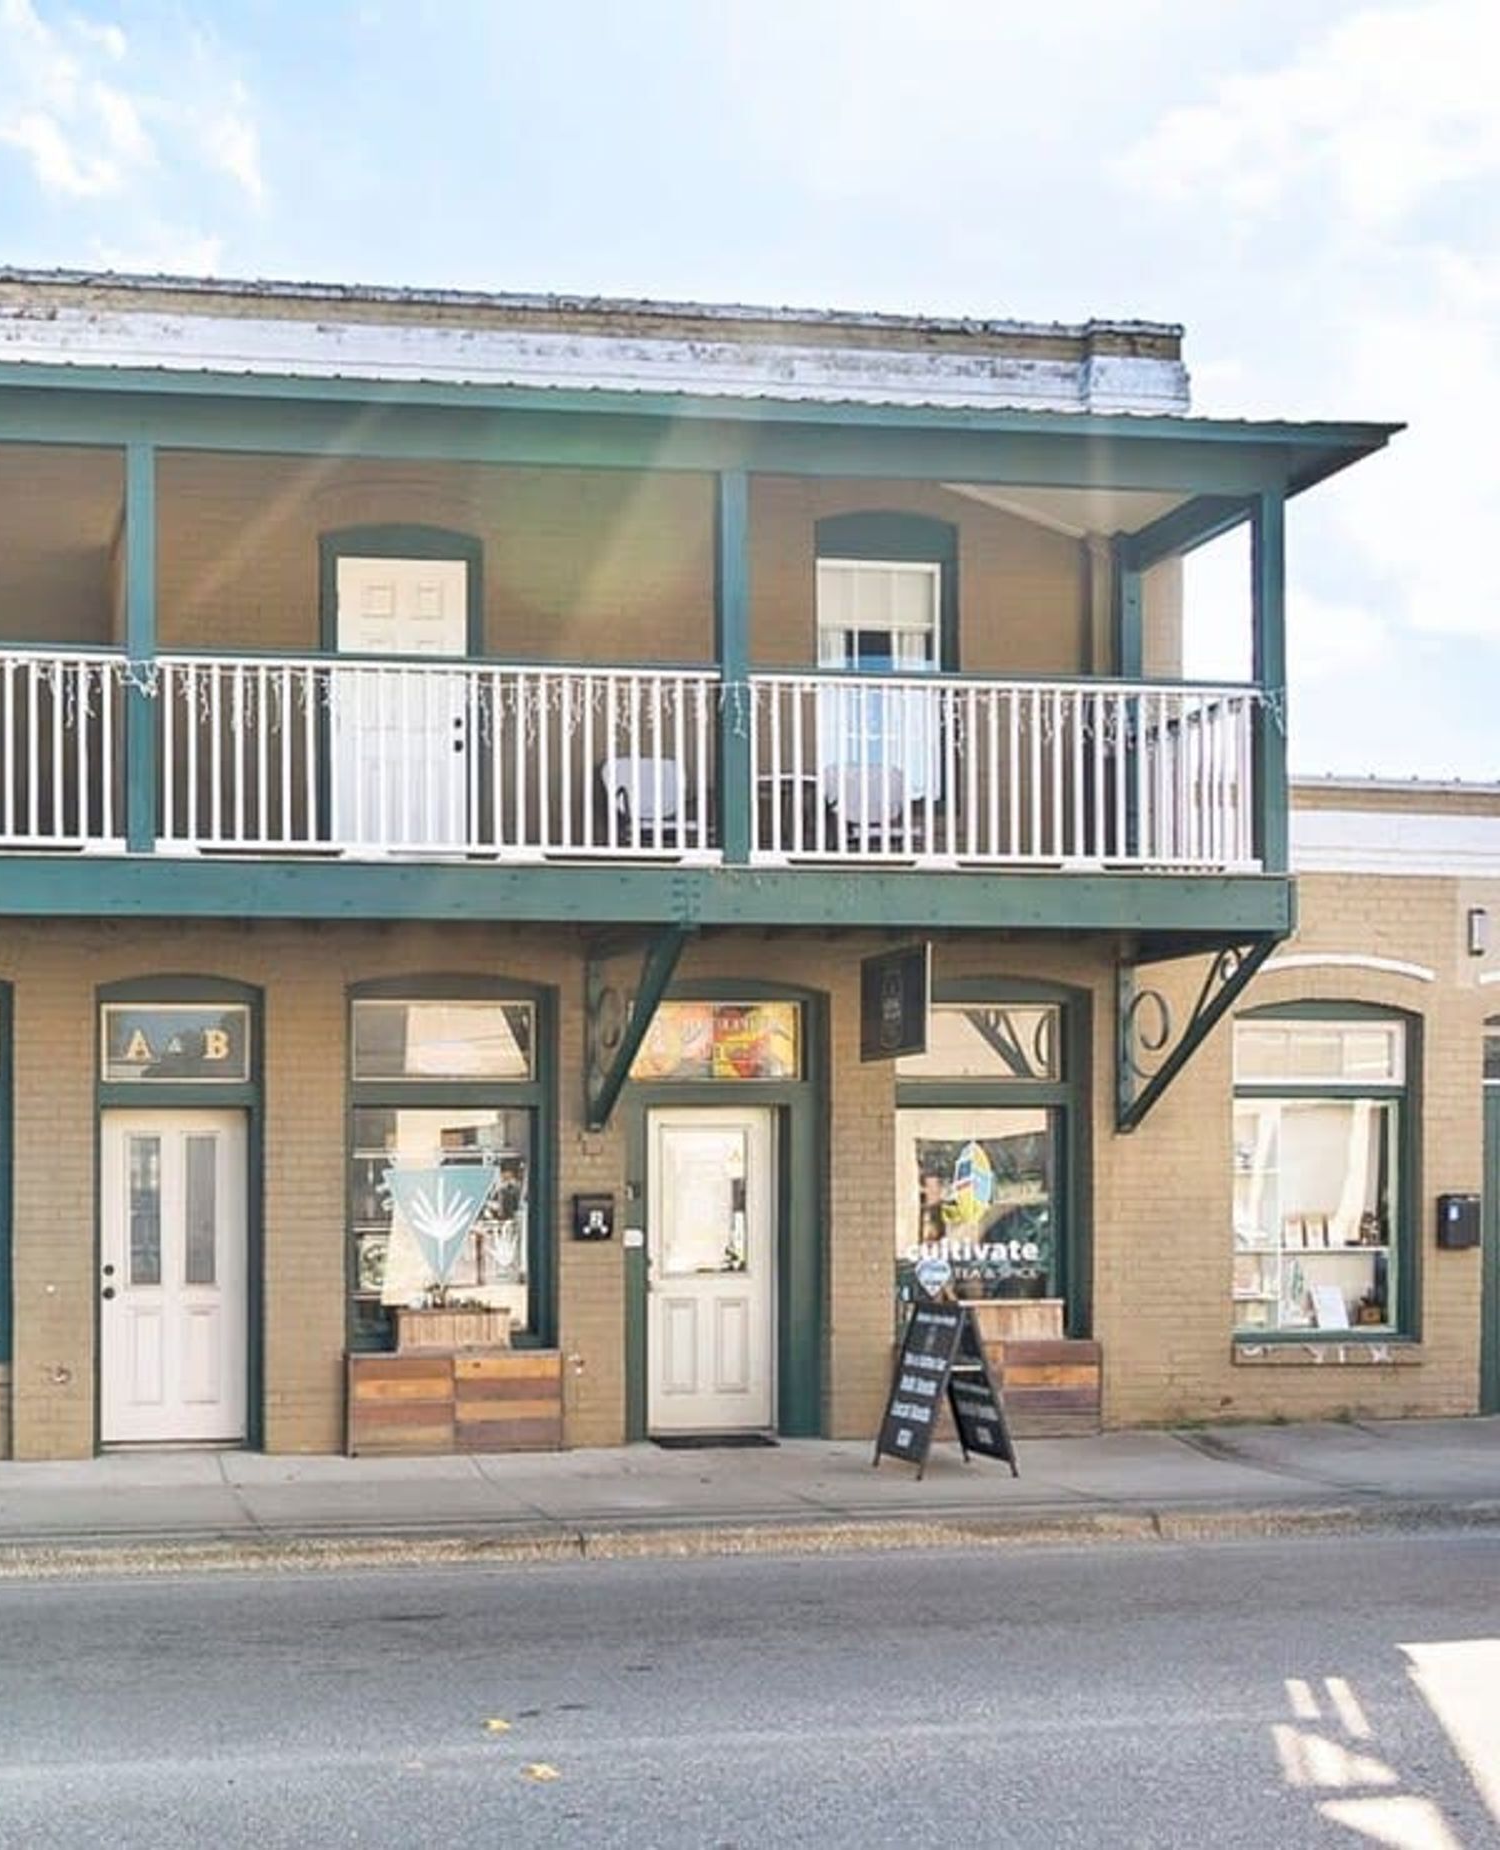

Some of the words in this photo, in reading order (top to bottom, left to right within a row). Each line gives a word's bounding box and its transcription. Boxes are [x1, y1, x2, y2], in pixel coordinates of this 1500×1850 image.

[124, 1028, 153, 1060] A
[202, 1028, 230, 1060] B
[904, 1236, 1040, 1262] cultivate
